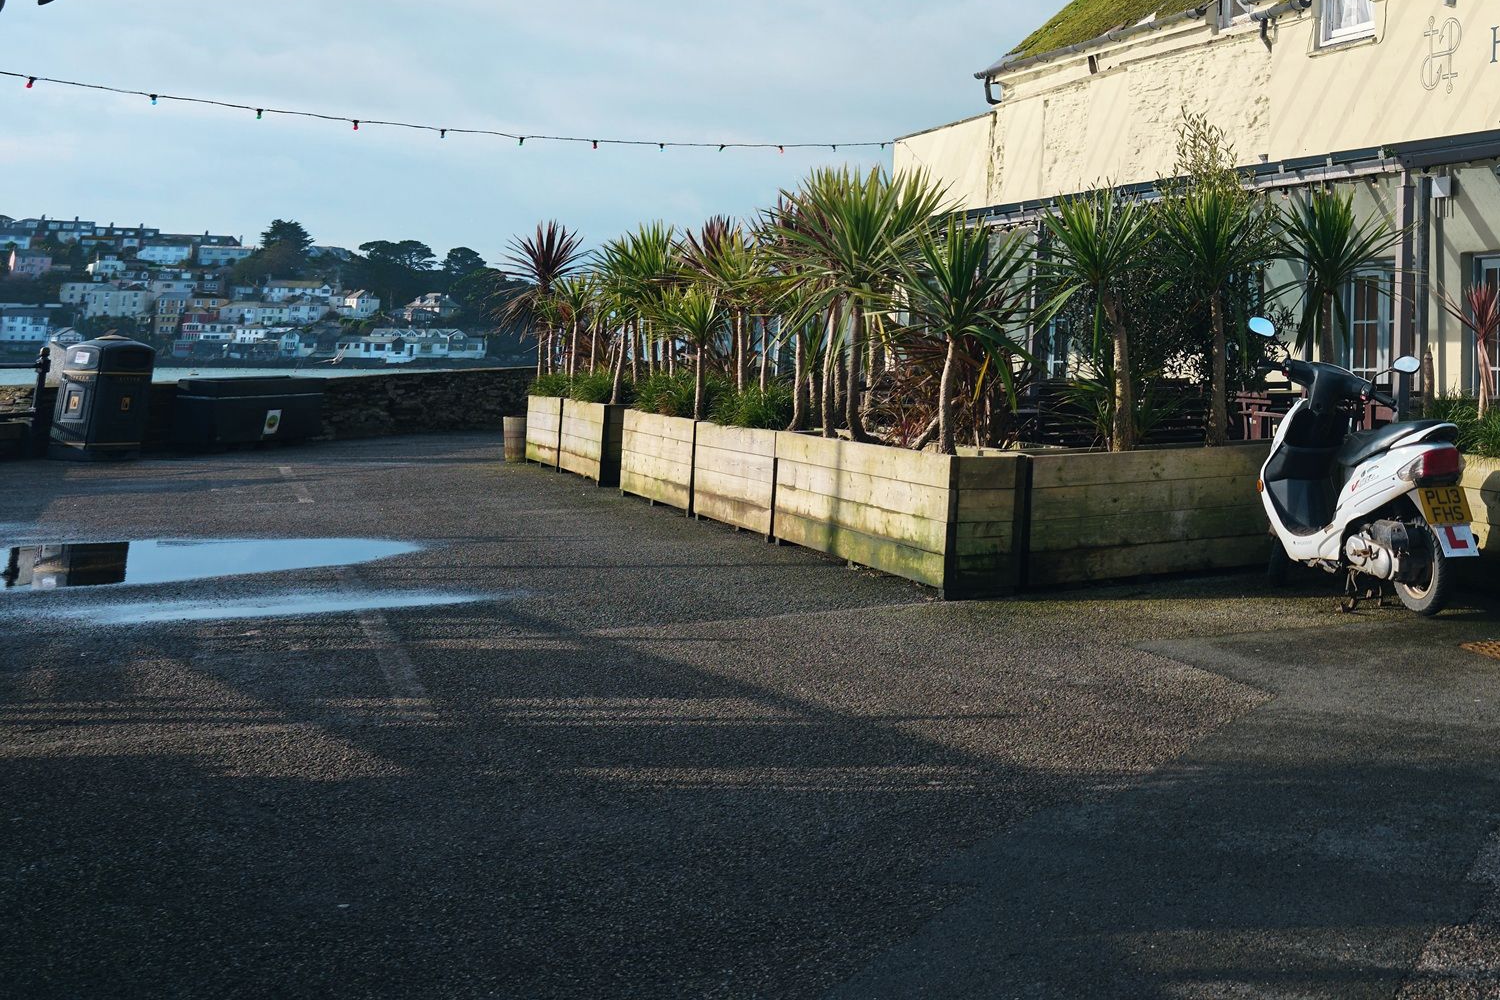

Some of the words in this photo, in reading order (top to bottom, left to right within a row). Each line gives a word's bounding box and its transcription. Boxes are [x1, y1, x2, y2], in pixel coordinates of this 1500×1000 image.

[1425, 489, 1461, 504] PL13
[1432, 506, 1464, 521] FHS
[1444, 526, 1469, 549] L
